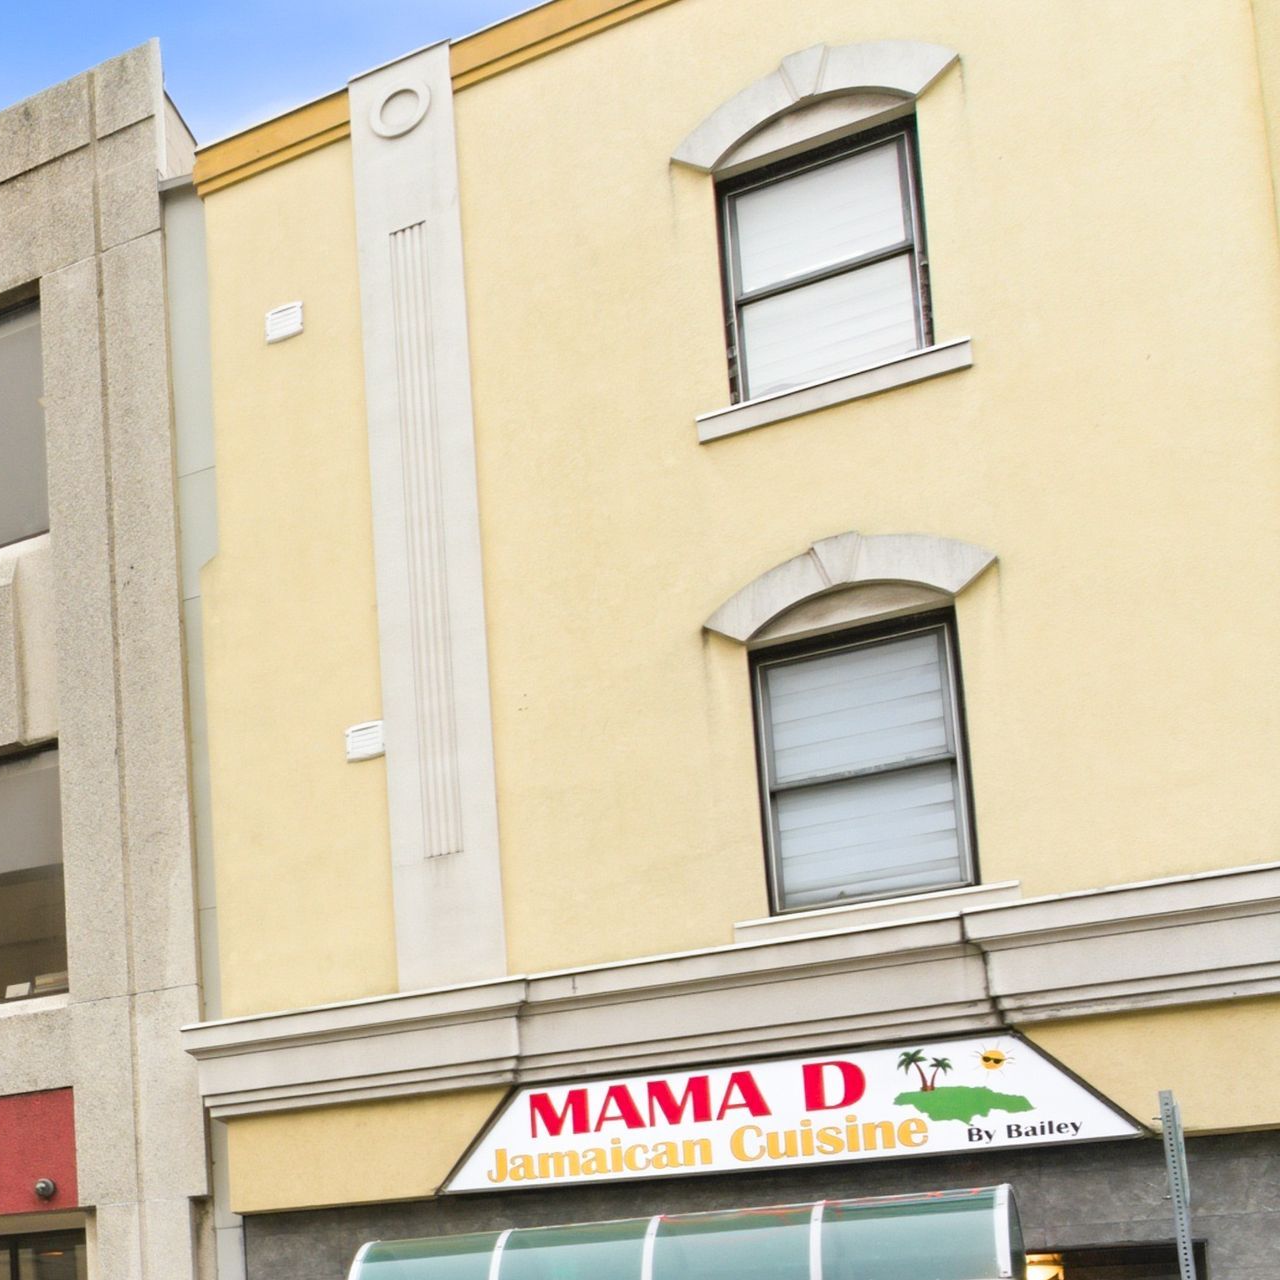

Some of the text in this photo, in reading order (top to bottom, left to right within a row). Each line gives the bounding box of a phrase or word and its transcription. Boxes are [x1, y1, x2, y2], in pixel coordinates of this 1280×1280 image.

[529, 1060, 867, 1139] MAMA D
[967, 1120, 1083, 1143] By Bailey
[487, 1114, 929, 1184] Jamaican Cuisine
